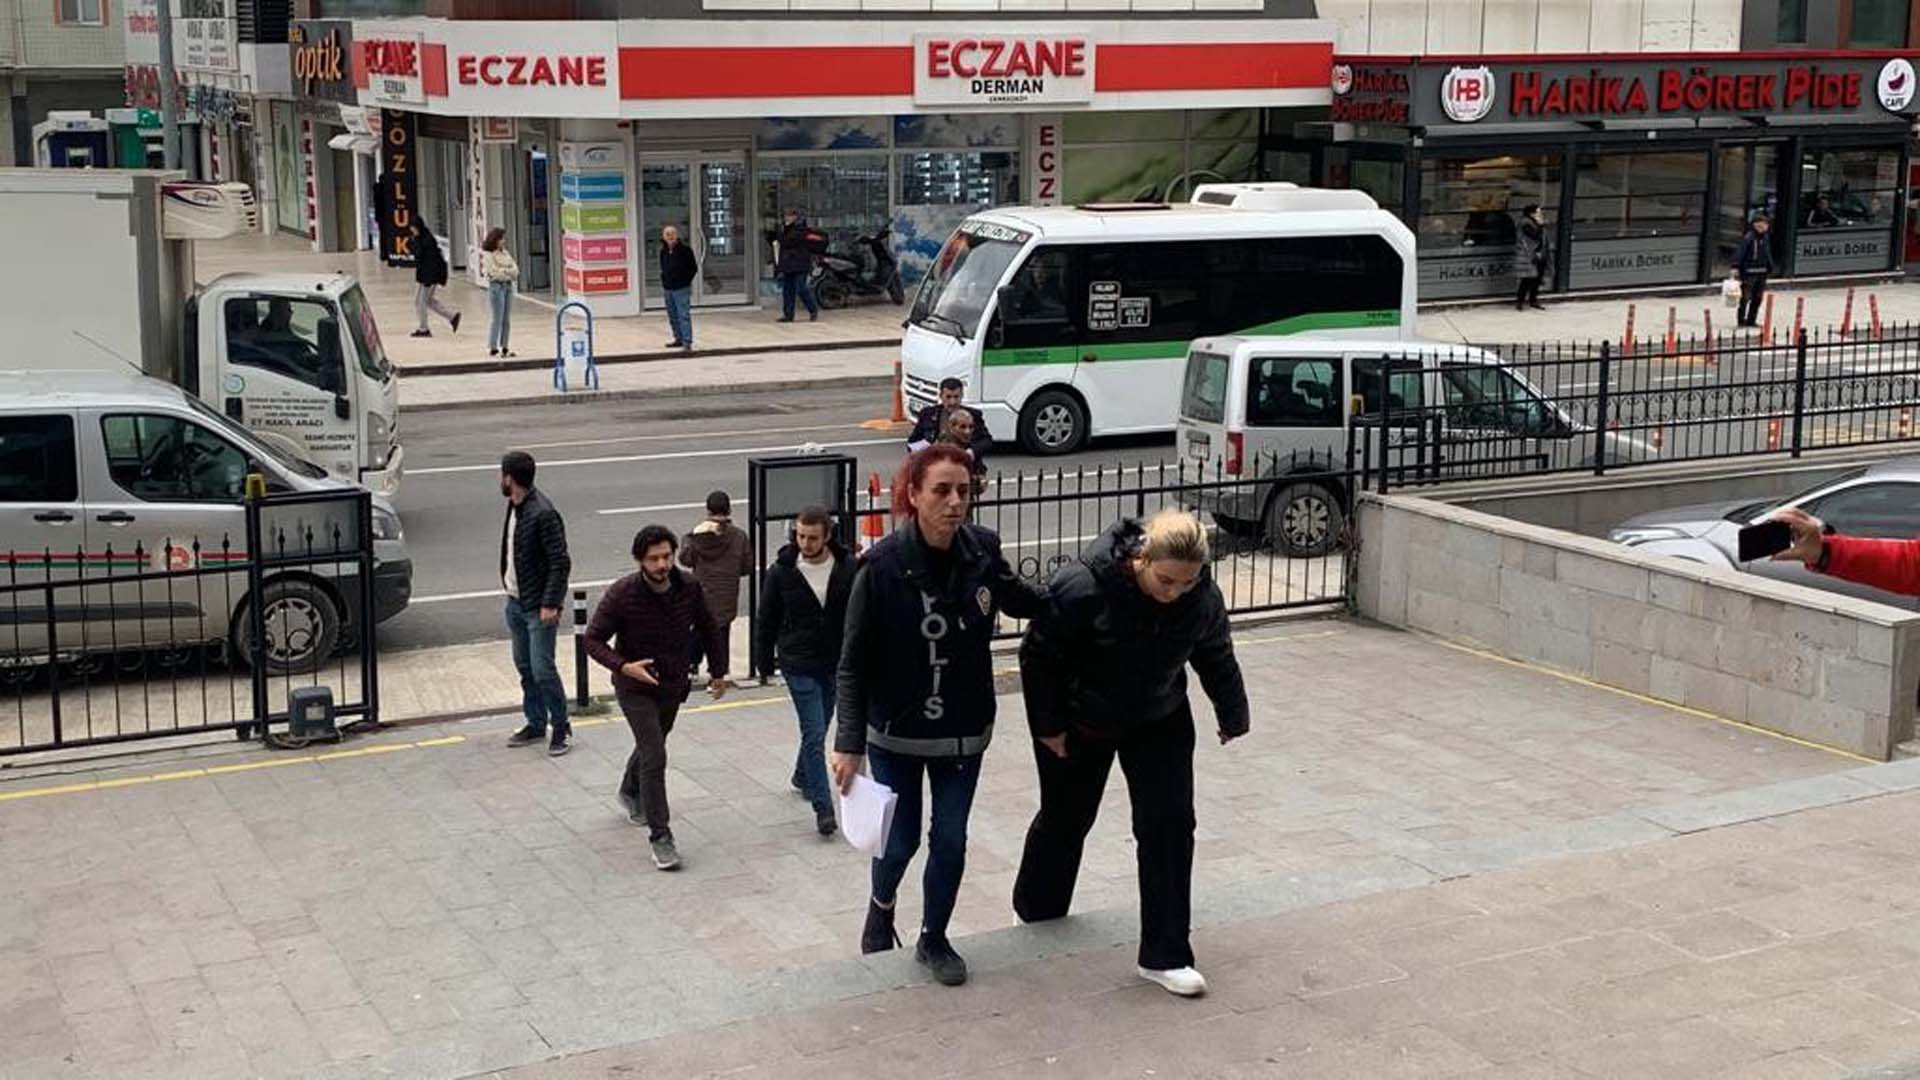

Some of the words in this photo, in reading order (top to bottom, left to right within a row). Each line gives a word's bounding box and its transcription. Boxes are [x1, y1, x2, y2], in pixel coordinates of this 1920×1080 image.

[295, 28, 342, 96] optik
[457, 55, 607, 87] ECZANE
[928, 40, 1086, 78] ECZANE
[971, 79, 1044, 95] DERMAN
[1455, 78, 1482, 102] HB
[1509, 68, 1649, 117] HARİKA
[1657, 65, 1776, 112] BÖREK
[1783, 65, 1862, 110] PİDE
[1038, 125, 1056, 207] ECZ
